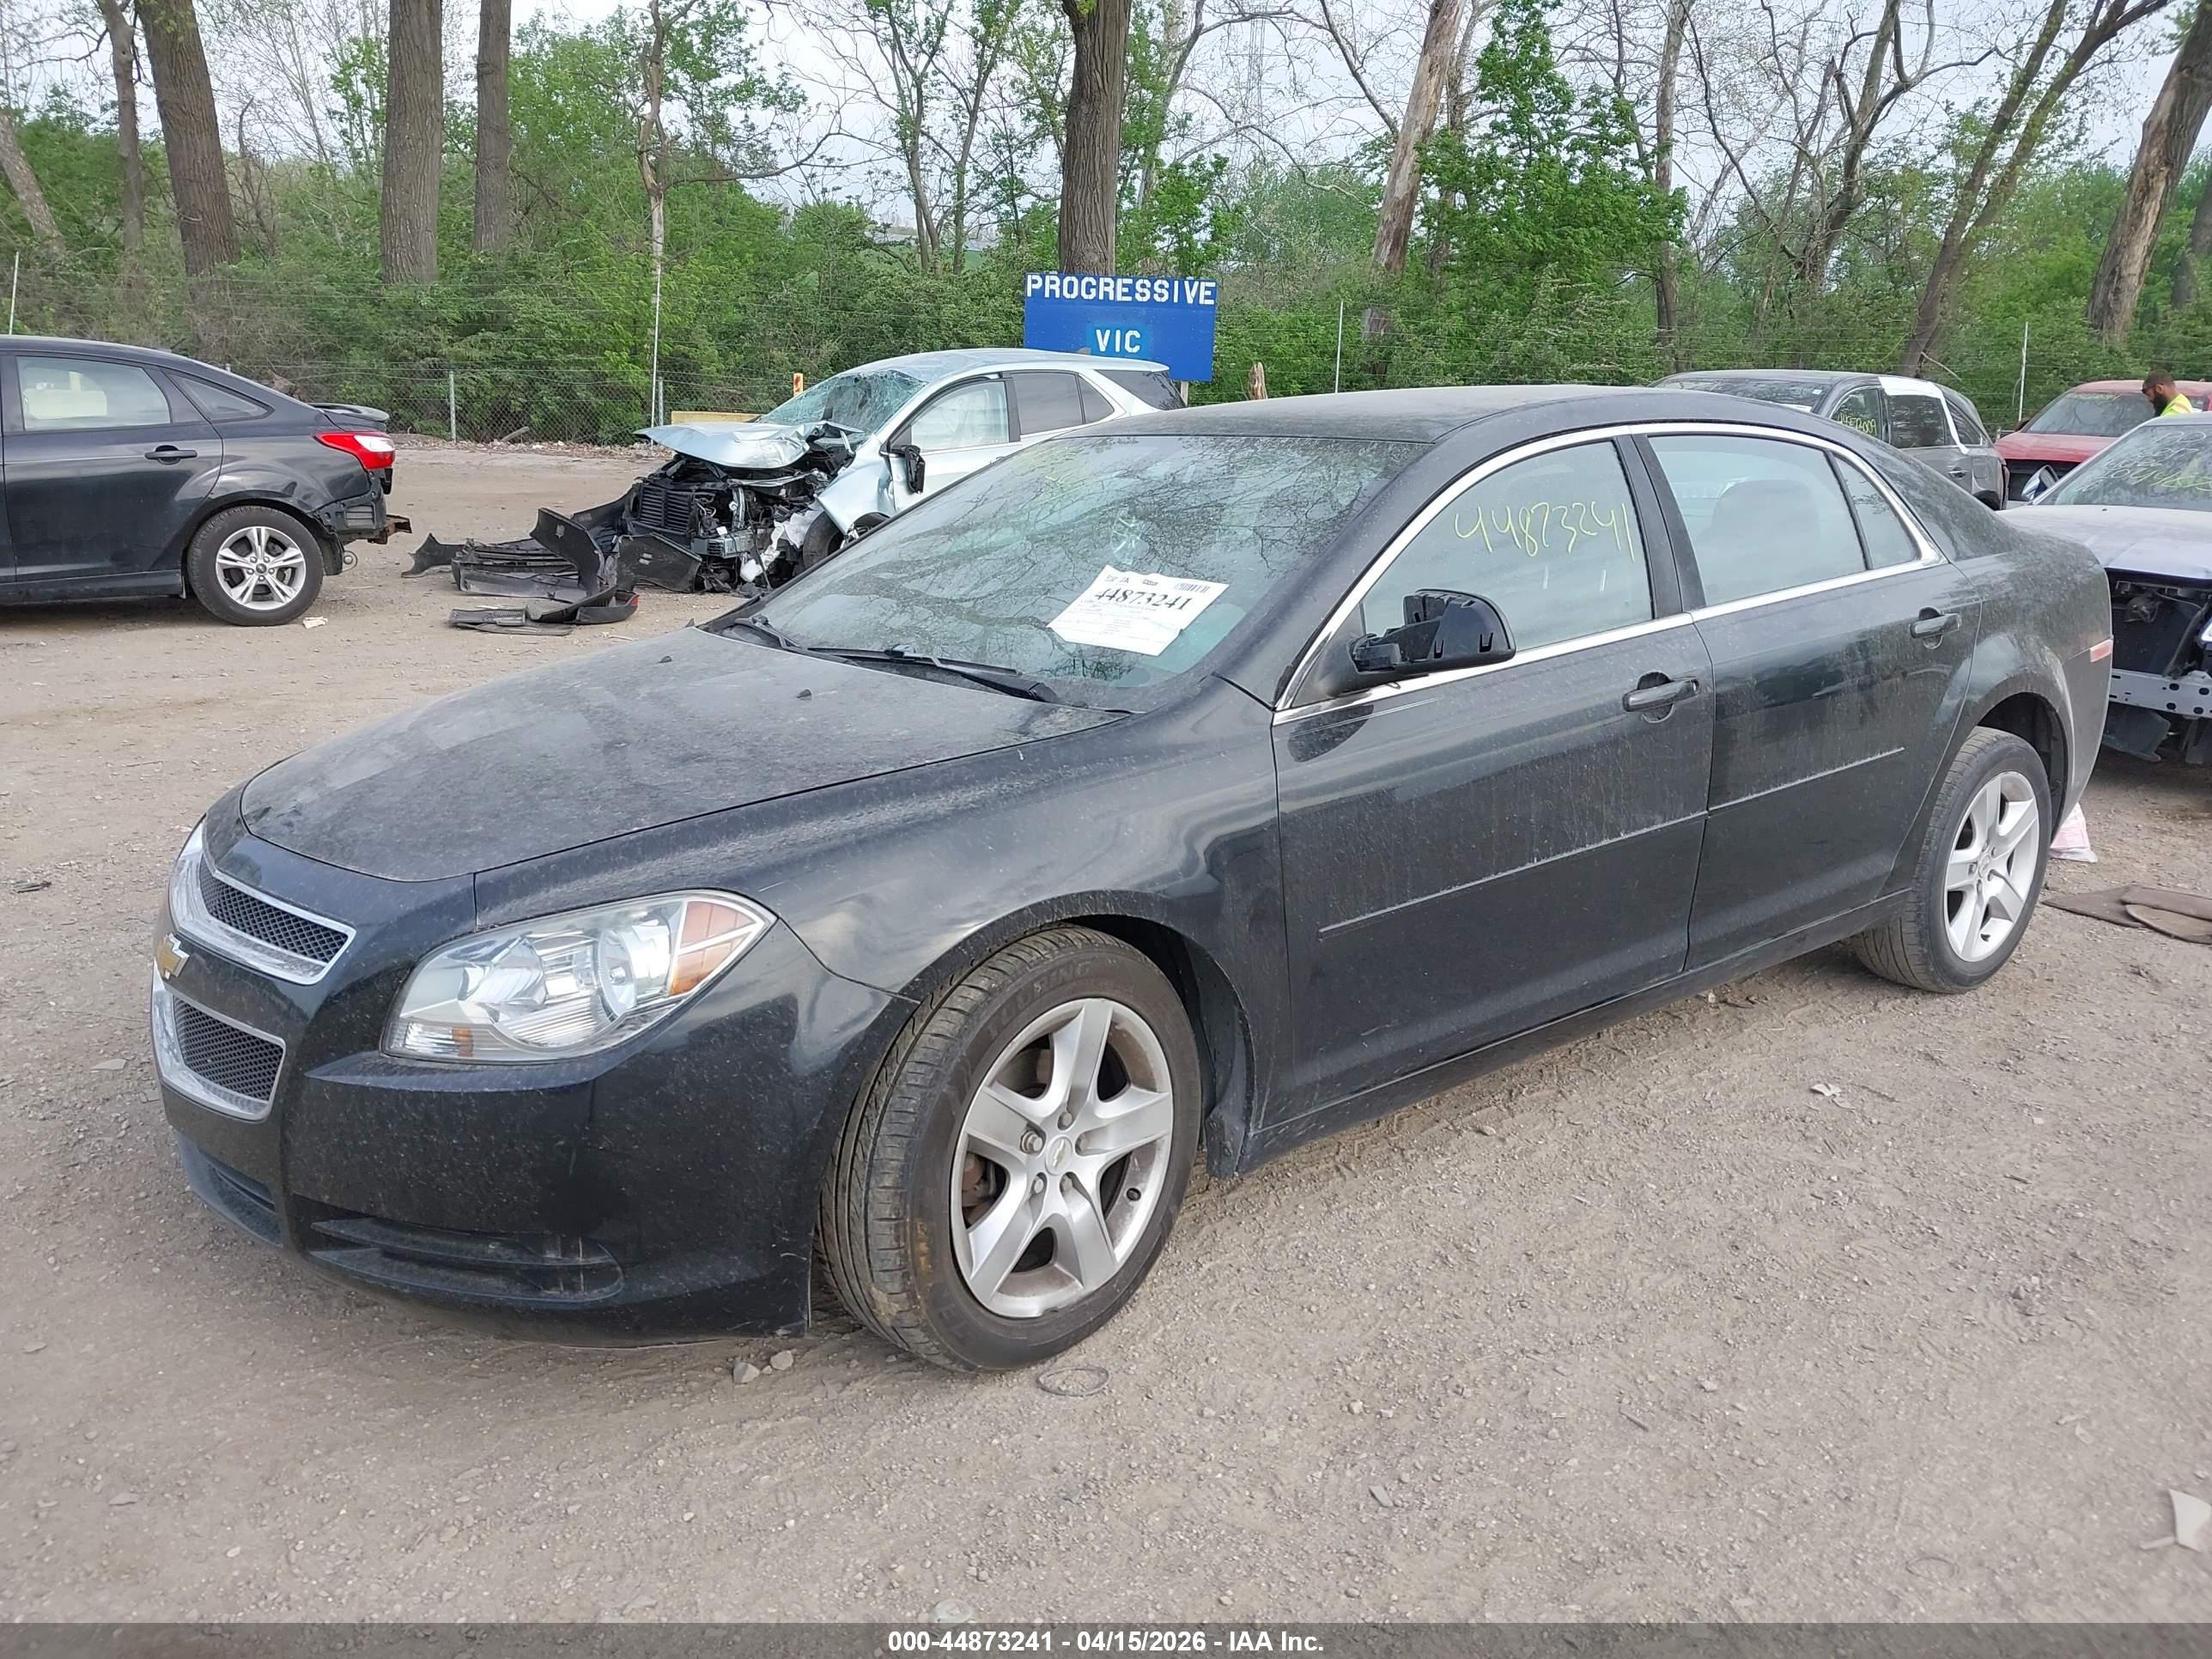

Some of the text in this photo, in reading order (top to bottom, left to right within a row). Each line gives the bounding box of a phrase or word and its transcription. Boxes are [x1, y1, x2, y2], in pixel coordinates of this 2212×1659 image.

[1026, 274, 1216, 305] PROGRESSIVE
[1096, 329, 1141, 353] VIC
[1455, 501, 1635, 562] 44873241
[1094, 587, 1194, 611] 44873241
